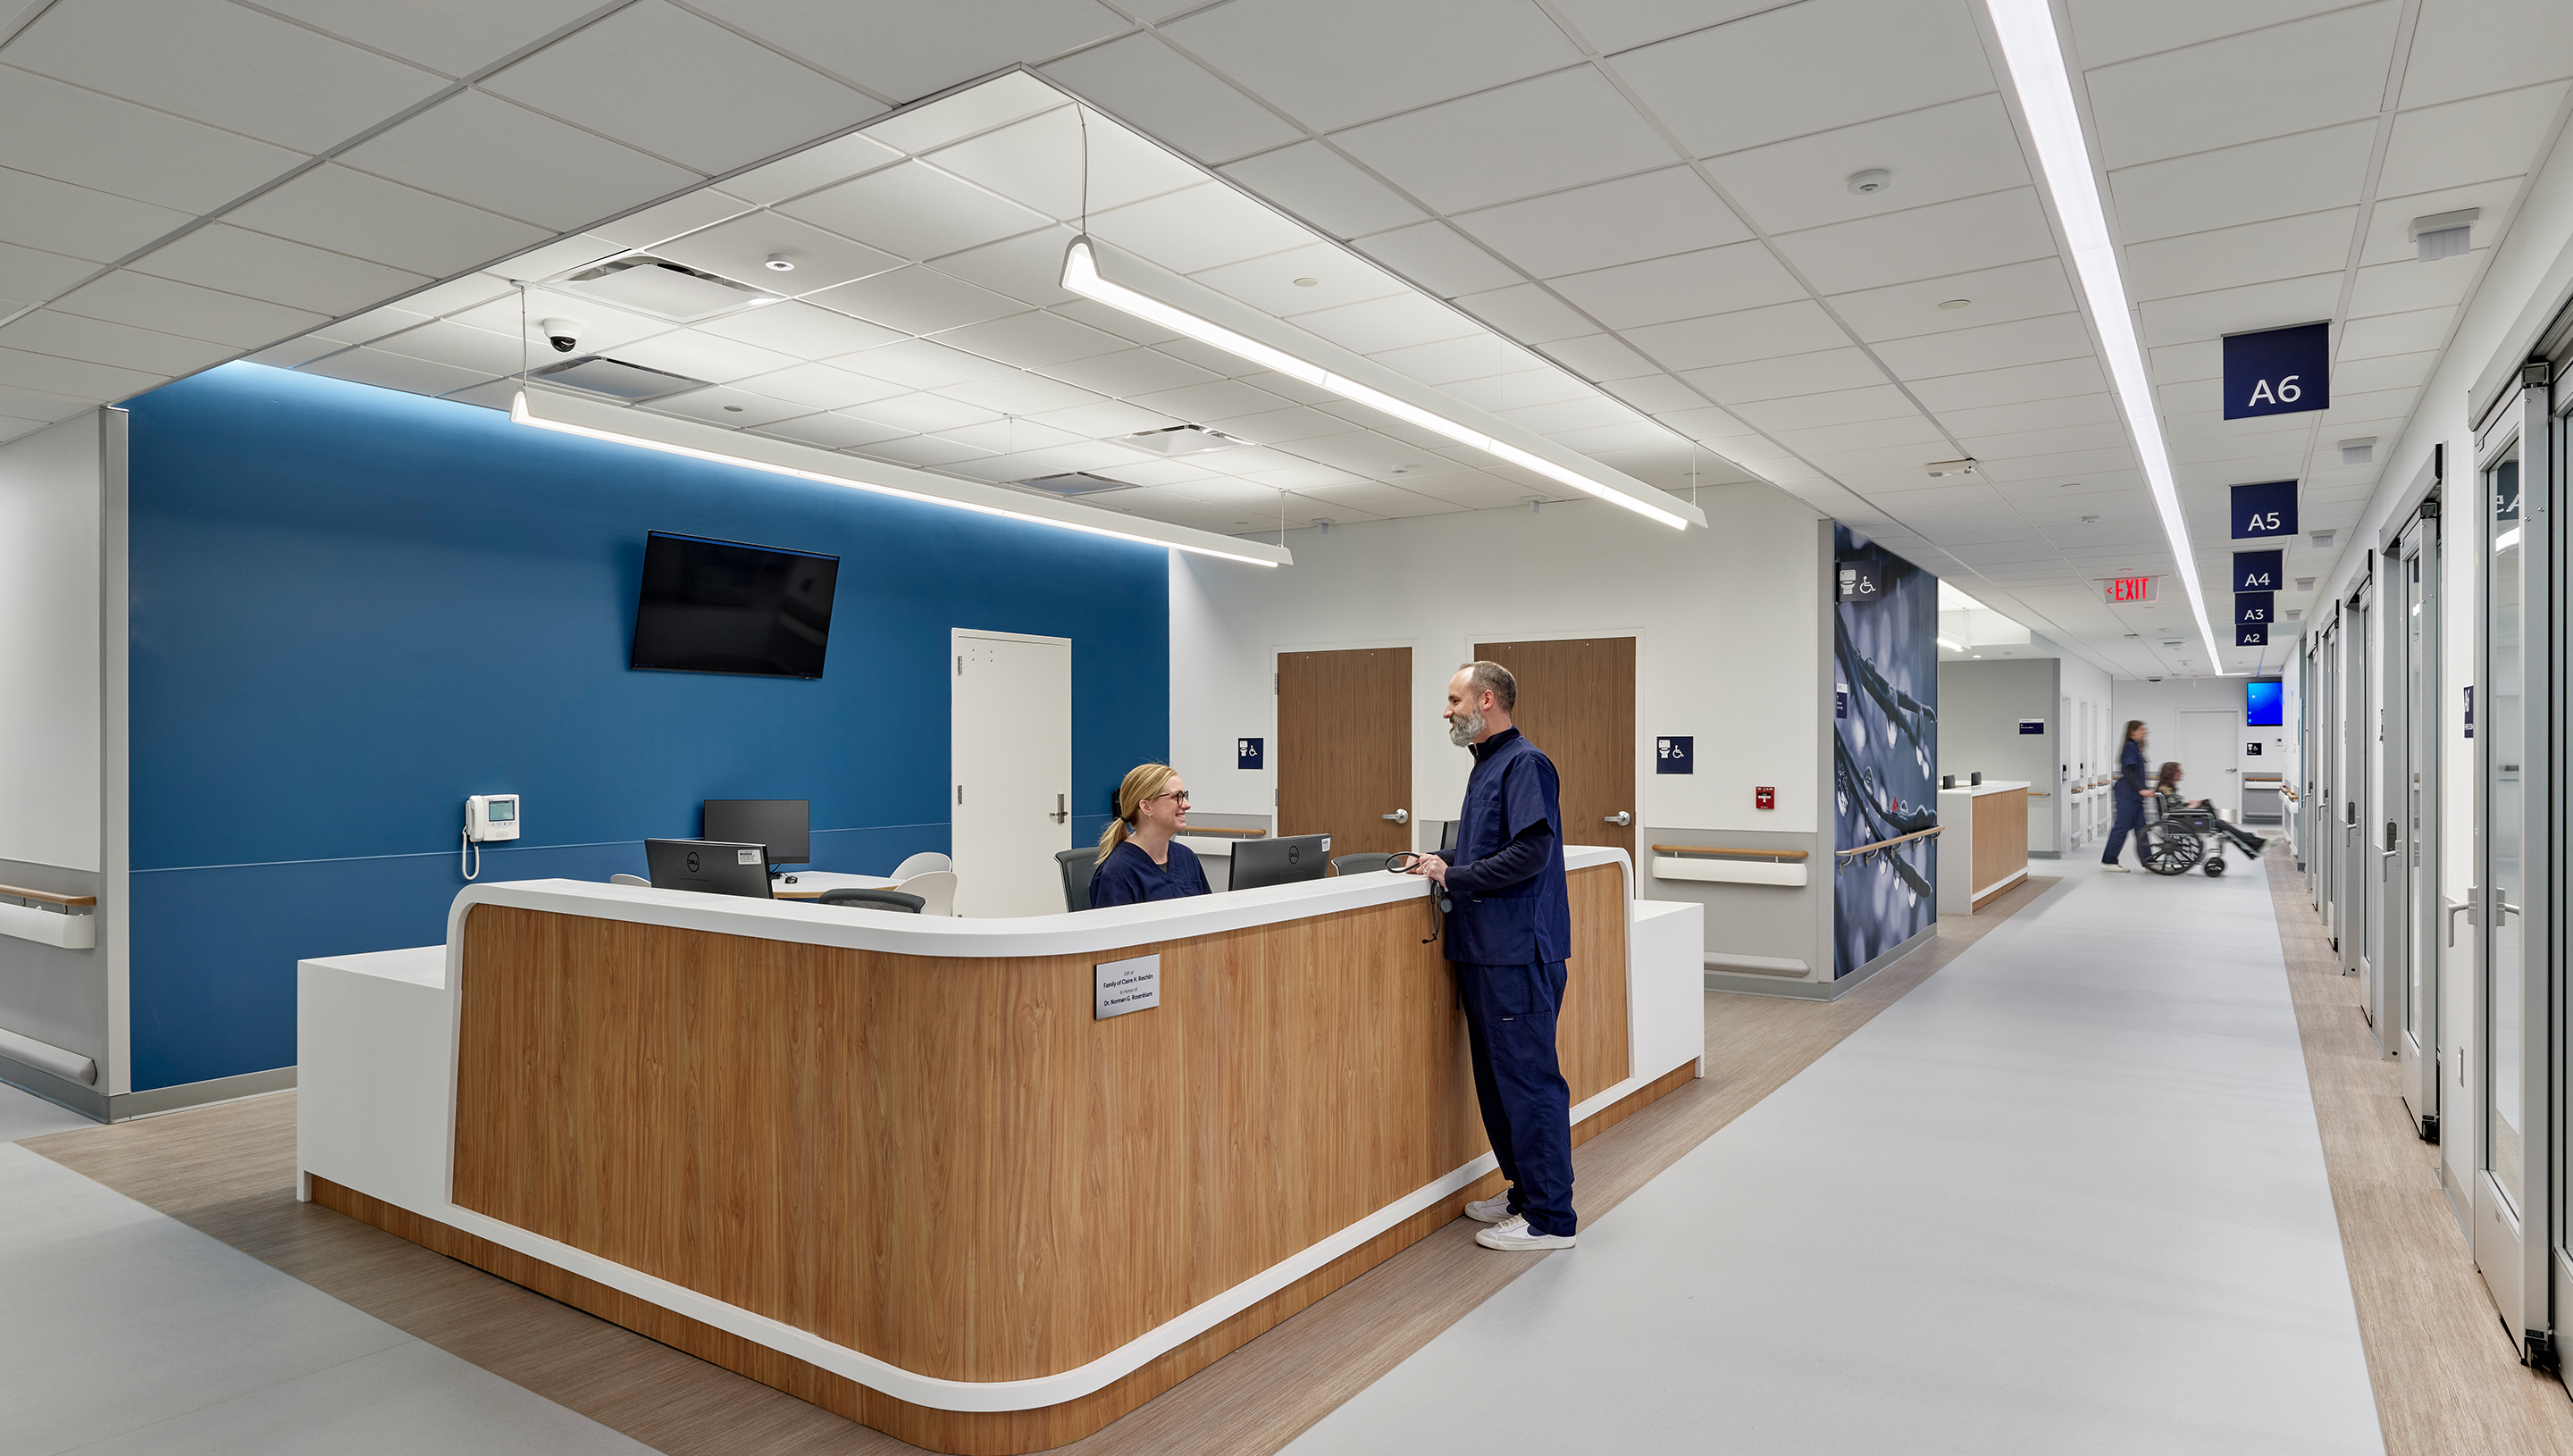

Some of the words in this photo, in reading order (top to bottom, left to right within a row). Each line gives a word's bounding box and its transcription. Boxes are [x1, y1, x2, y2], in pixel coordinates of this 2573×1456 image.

[2248, 374, 2301, 407] A6
[2247, 512, 2281, 531] A5
[2244, 573, 2271, 588] A4
[2115, 578, 2150, 601] EXIT
[2243, 609, 2265, 621] A3
[2243, 633, 2261, 643] A2
[1132, 992, 1152, 1000] Rosenblum
